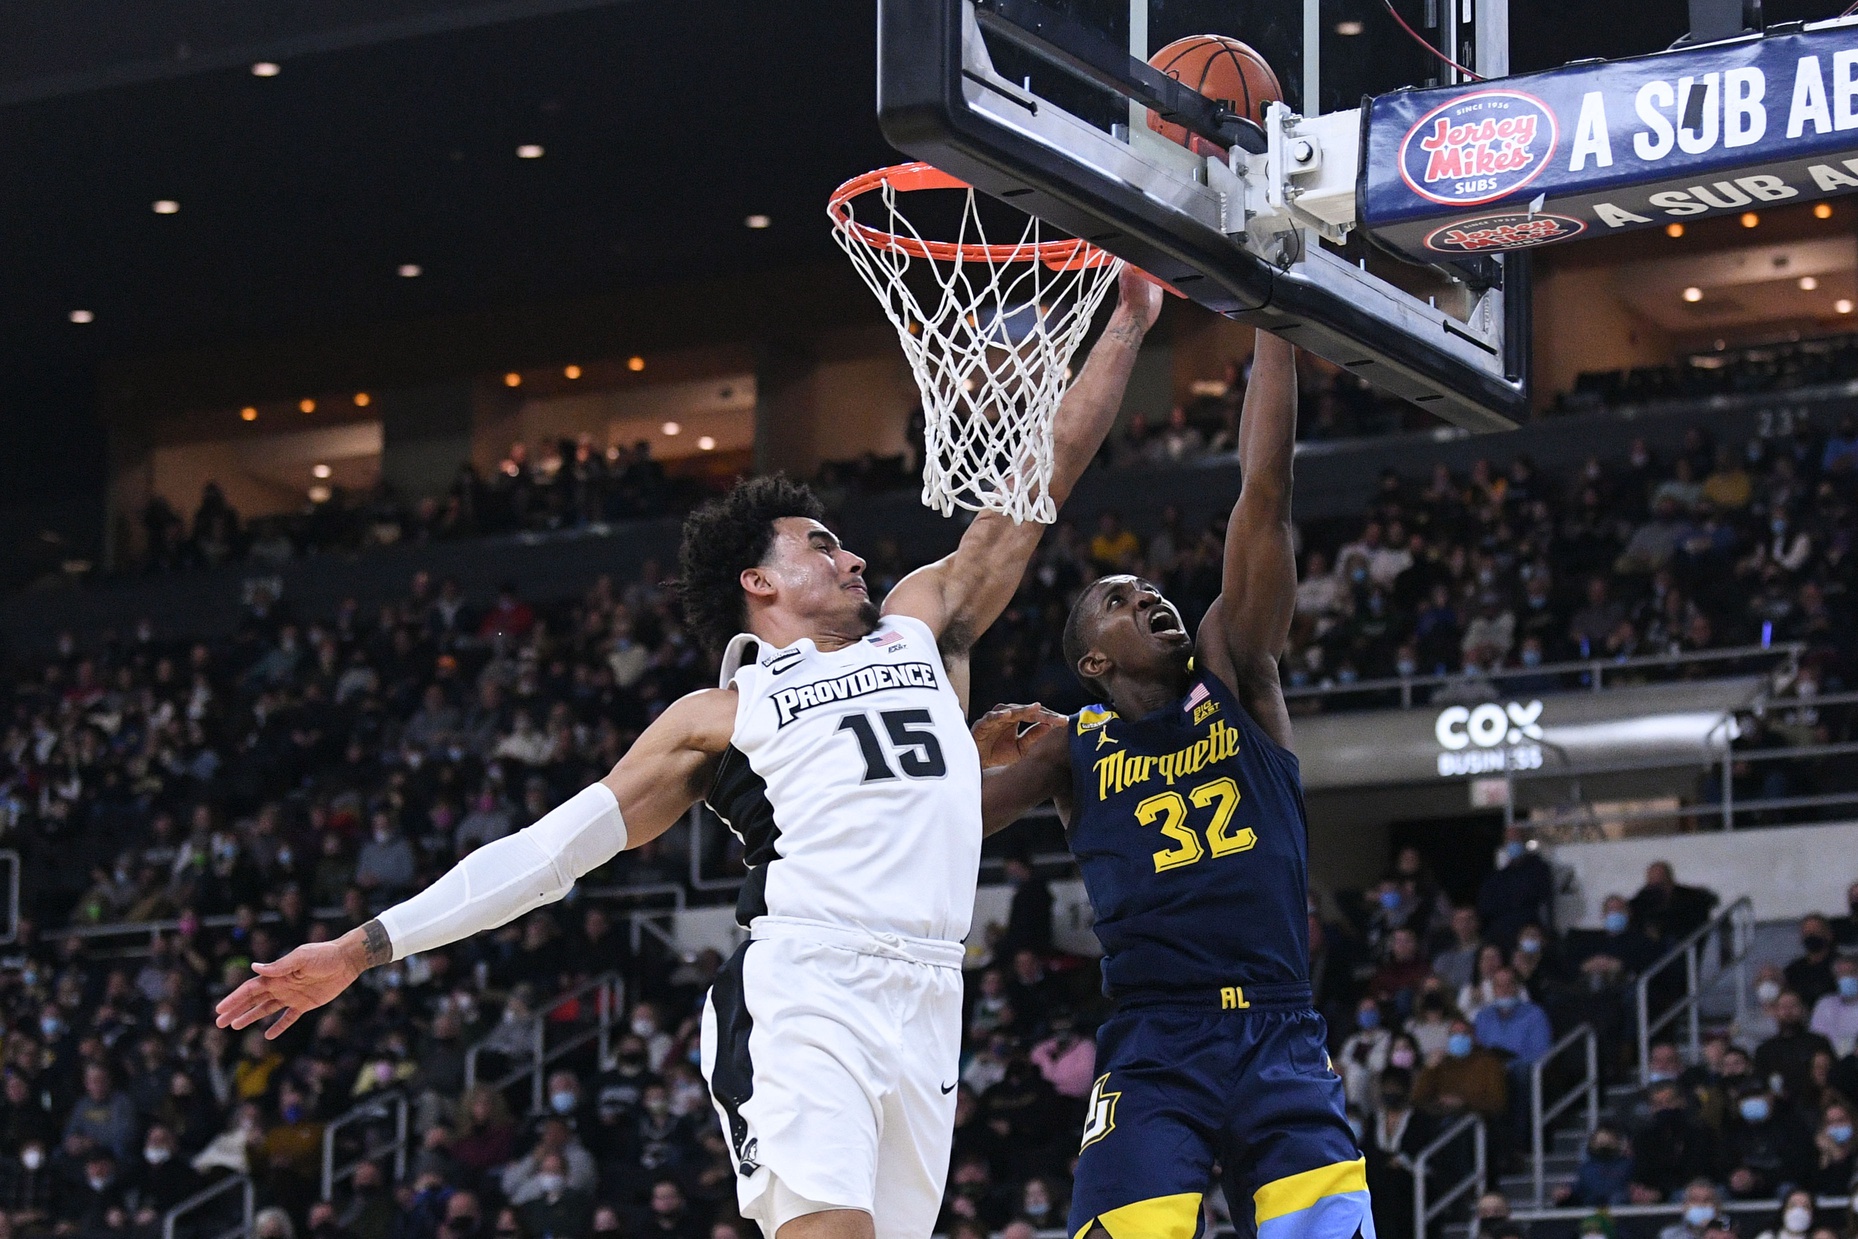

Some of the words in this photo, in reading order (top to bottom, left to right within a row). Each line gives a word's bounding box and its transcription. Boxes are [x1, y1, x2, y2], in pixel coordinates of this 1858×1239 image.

[1456, 103, 1483, 116] SINCE
[1487, 102, 1510, 110] 1956
[1569, 91, 1613, 172] A
[1633, 66, 1767, 161] SUB
[1420, 114, 1538, 151] Jersey
[1424, 141, 1534, 182] Mike's
[1455, 177, 1498, 195] SUBS
[1593, 202, 1654, 228] A
[1649, 174, 1799, 216] SUB
[1807, 158, 1858, 192] A
[1444, 219, 1560, 244] Jersey
[769, 662, 939, 730] PROVIDENCE
[1193, 699, 1212, 717] BIG
[1193, 701, 1220, 724] EAST
[1435, 699, 1543, 750] COX
[832, 707, 949, 786] 15
[1092, 719, 1240, 802] Marquette
[1133, 776, 1258, 874] 32
[1220, 986, 1250, 1010] AL
